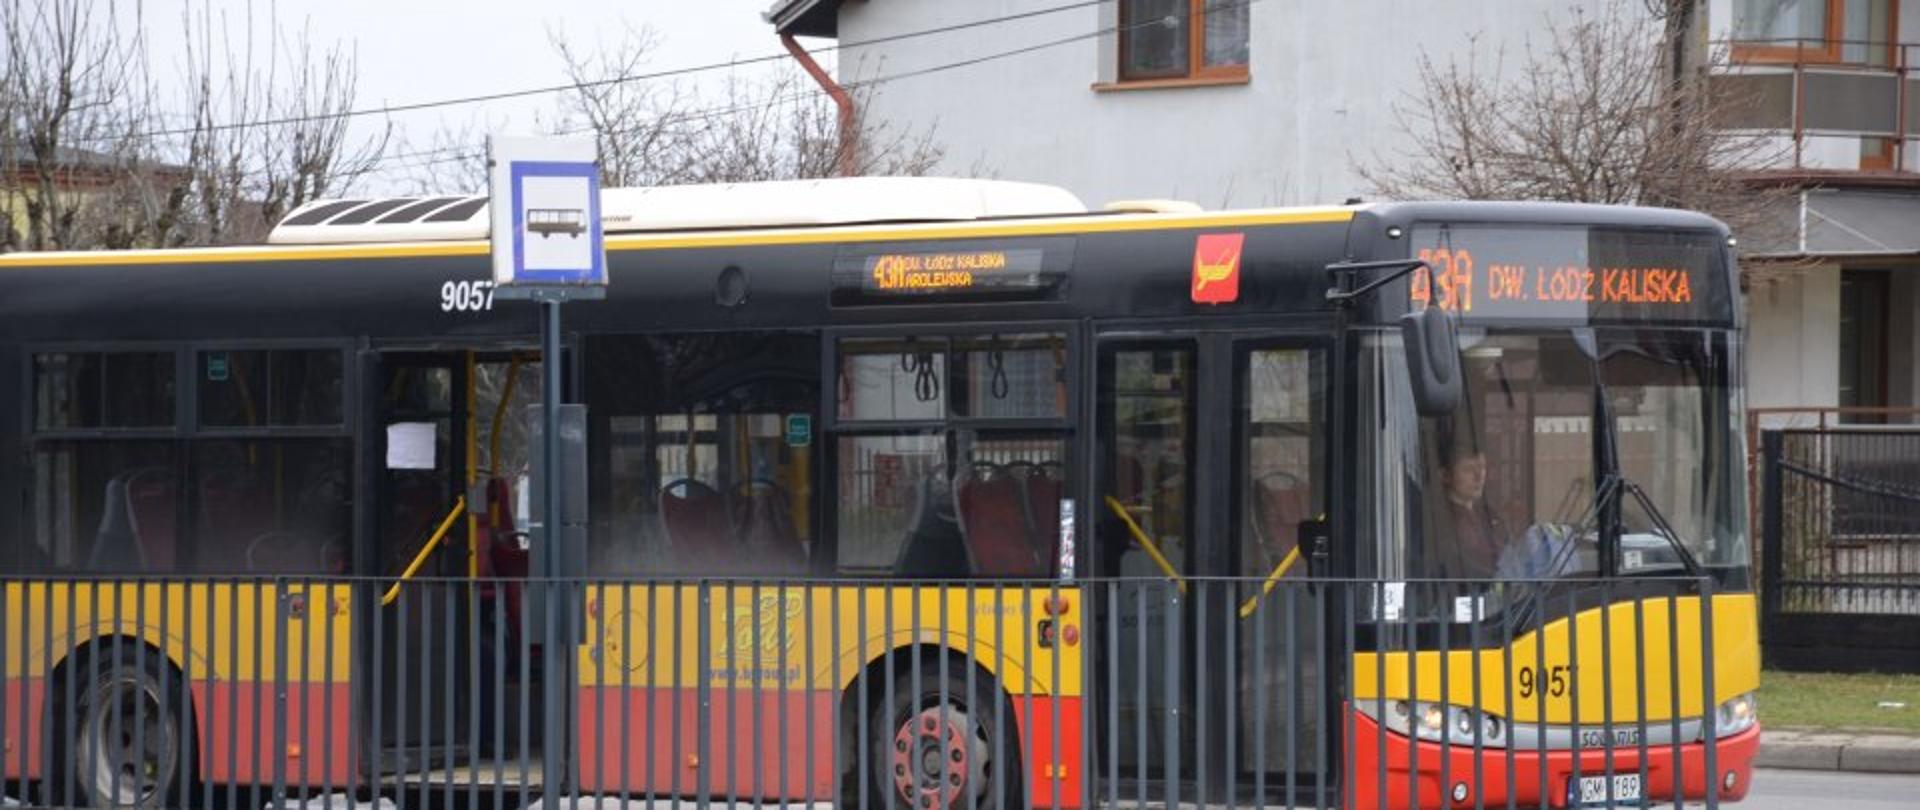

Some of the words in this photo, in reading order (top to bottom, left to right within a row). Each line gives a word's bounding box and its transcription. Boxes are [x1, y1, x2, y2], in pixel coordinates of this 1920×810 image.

[873, 254, 905, 288] 43A
[957, 251, 1005, 268] KALISKA
[1411, 248, 1472, 311] 43A
[1489, 264, 1527, 301] DW.
[1602, 267, 1691, 302] KALISKA
[441, 280, 498, 311] 9057
